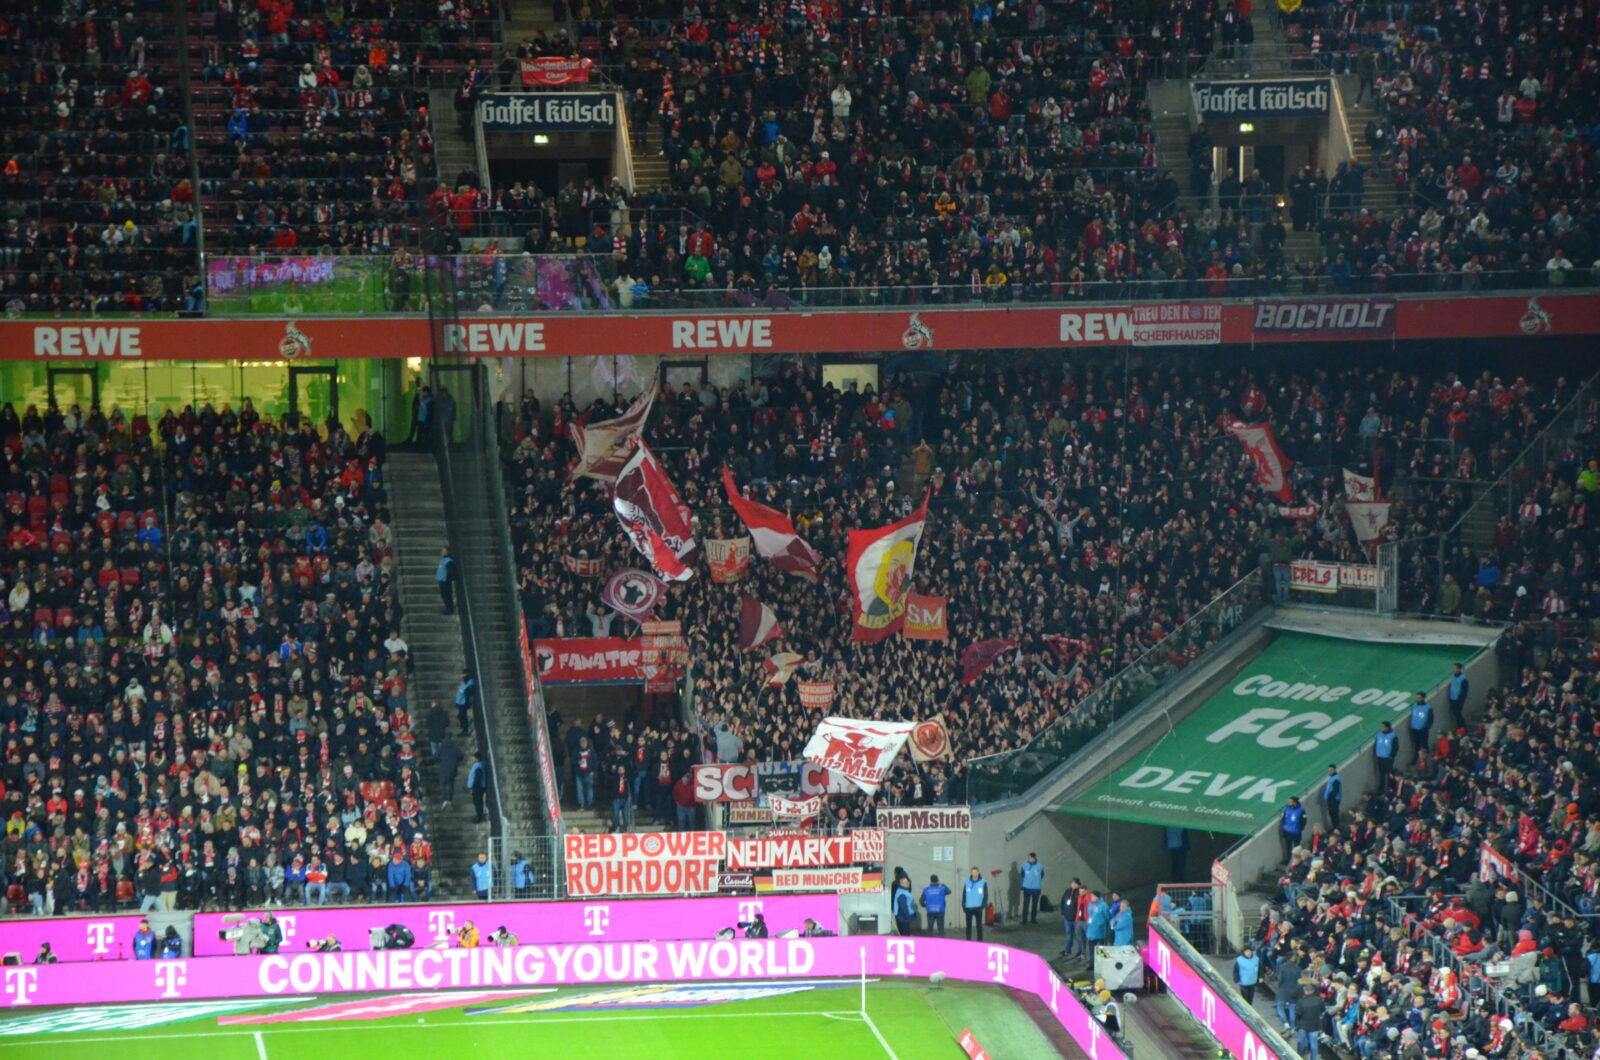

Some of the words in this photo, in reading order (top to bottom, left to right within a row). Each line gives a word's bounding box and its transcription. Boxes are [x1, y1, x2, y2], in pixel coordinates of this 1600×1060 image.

[481, 97, 543, 125] Gaffel
[545, 99, 614, 125] Kölsch
[1197, 86, 1256, 113] Gaffel
[1260, 85, 1327, 112] Kölsch
[1060, 312, 1135, 342] REW
[1133, 307, 1158, 321] TREU
[1161, 305, 1180, 320] DEN
[1255, 303, 1395, 329] BOCHOLT
[34, 327, 142, 356] REWE
[444, 323, 546, 352] REWE
[672, 319, 772, 348] REWE
[1133, 328, 1220, 342] SCHERFHAUSEN
[906, 603, 943, 626] SM
[1233, 674, 1352, 701] Come
[1206, 707, 1364, 752] FC!
[1118, 765, 1298, 804] DEVK
[877, 810, 970, 831] alarMstufe
[565, 833, 617, 859] RED
[621, 831, 725, 858] POWER
[727, 838, 851, 867] NEUMARKT
[567, 859, 718, 895] ROHRDORF
[776, 874, 799, 886] RED
[258, 944, 546, 994] CONNECTING
[546, 942, 660, 982] YOUR
[666, 939, 815, 978] WORLD
